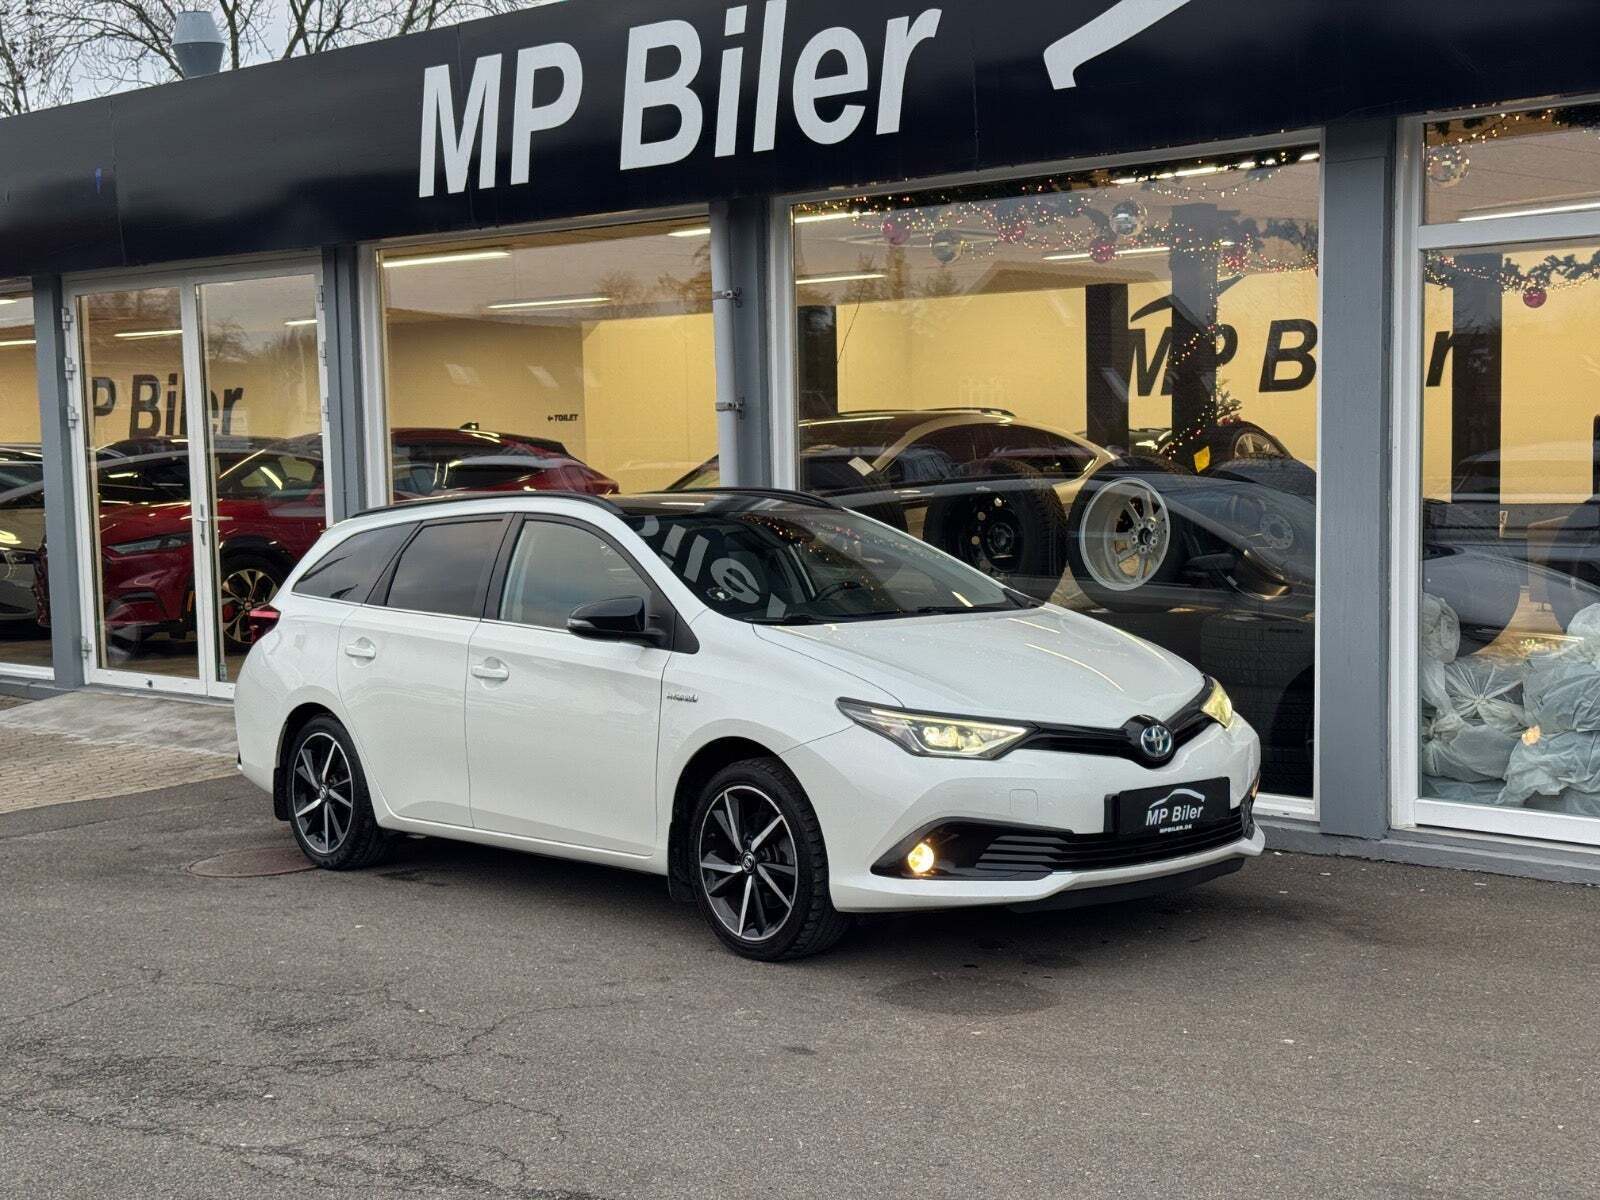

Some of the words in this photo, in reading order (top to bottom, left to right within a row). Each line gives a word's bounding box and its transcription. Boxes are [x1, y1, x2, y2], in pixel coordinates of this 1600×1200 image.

[419, 42, 583, 198] MP
[620, 0, 942, 171] Biler
[1145, 808, 1168, 826] MP
[1171, 804, 1204, 822] Biler
